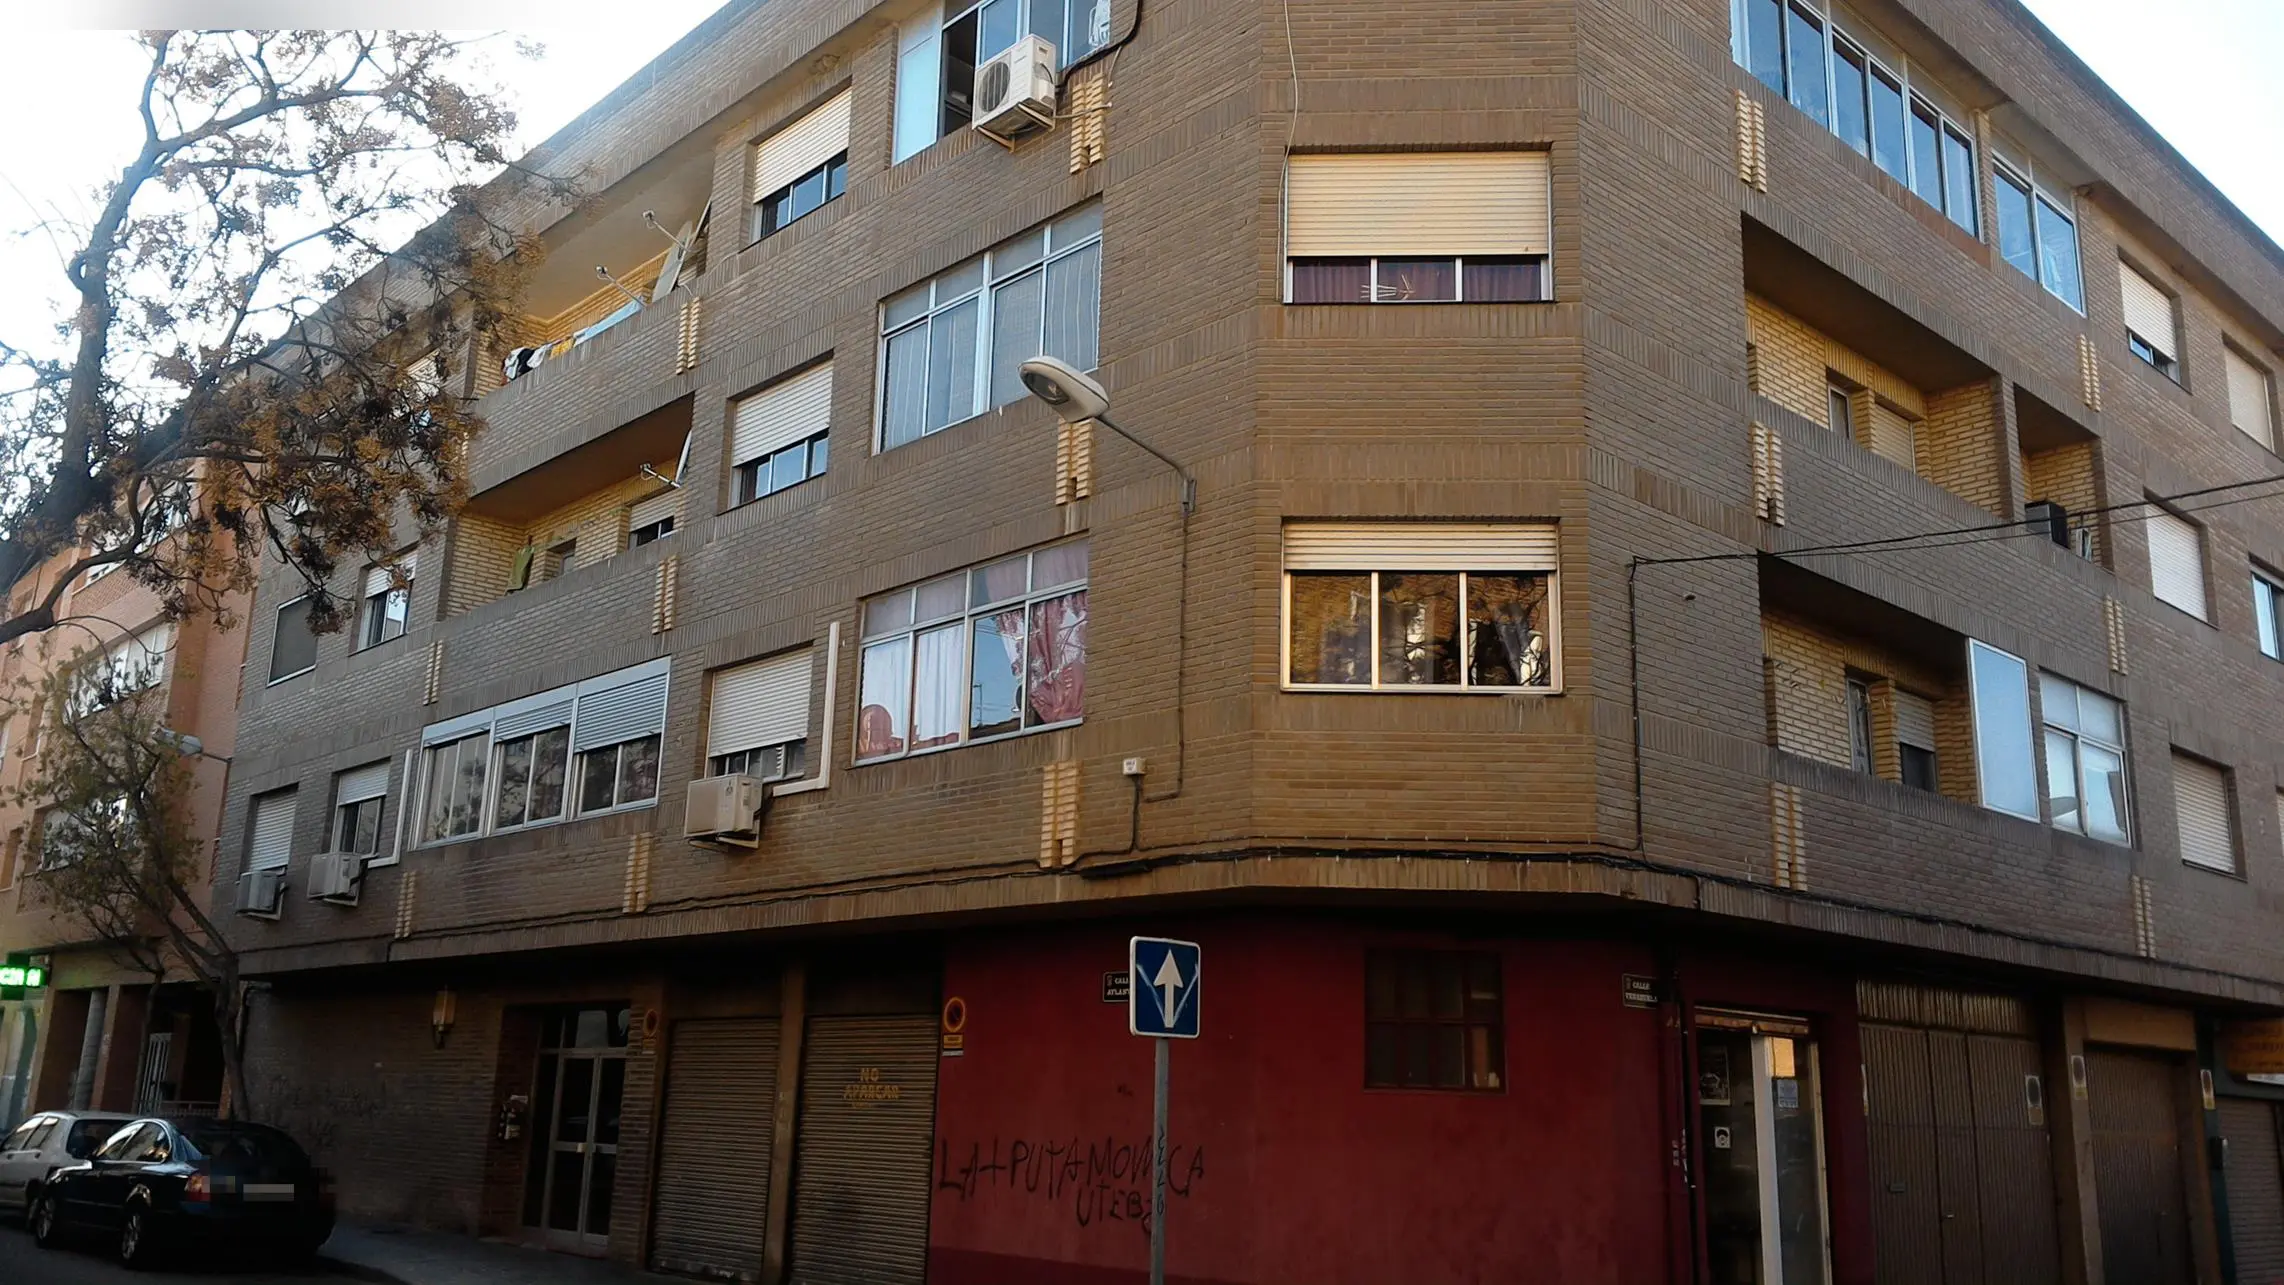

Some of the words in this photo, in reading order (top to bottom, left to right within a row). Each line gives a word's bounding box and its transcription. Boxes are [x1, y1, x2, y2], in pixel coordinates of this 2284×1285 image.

[859, 1067, 881, 1082] NO
[843, 1084, 901, 1099] APARCAR
[1086, 1135, 1205, 1197] MONCA
